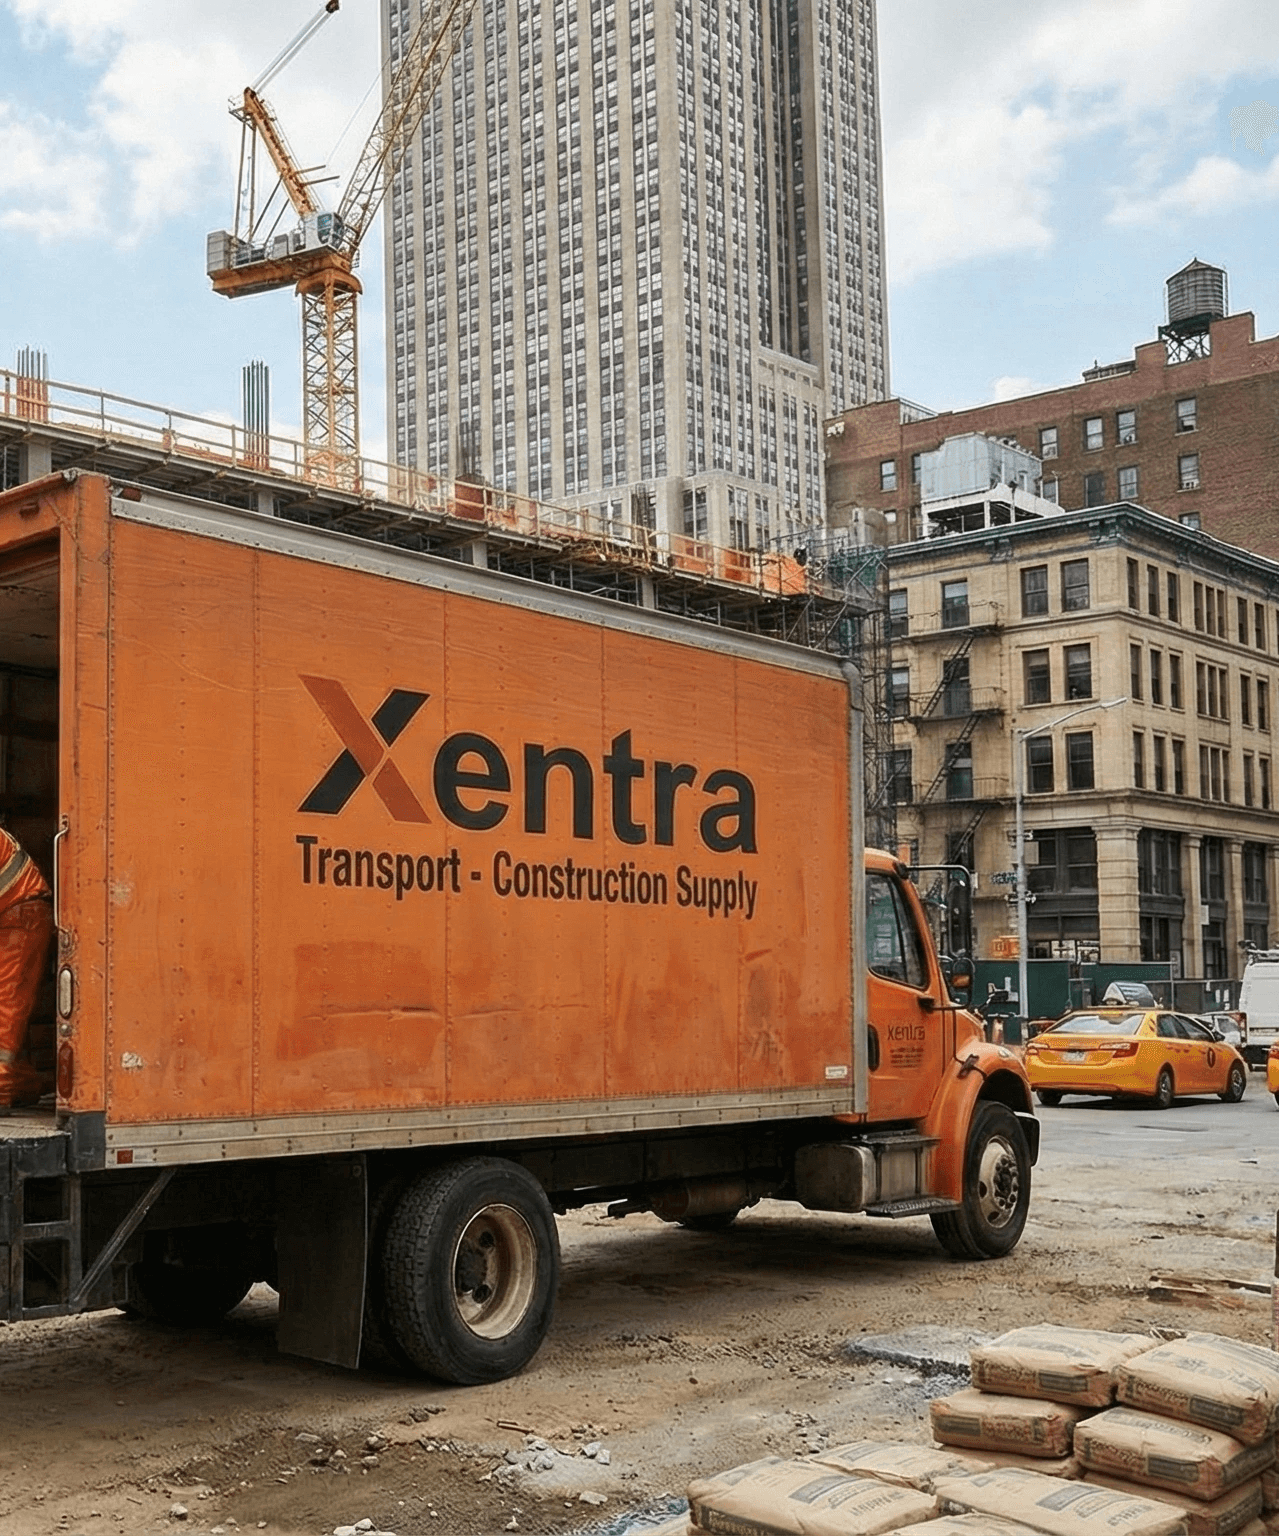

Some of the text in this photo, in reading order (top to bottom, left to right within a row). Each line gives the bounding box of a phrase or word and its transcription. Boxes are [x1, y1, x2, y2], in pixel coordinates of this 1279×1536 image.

[297, 673, 759, 855] Xentra
[295, 834, 462, 901] Transport
[493, 850, 668, 906] Construction
[676, 864, 759, 921] Supply
